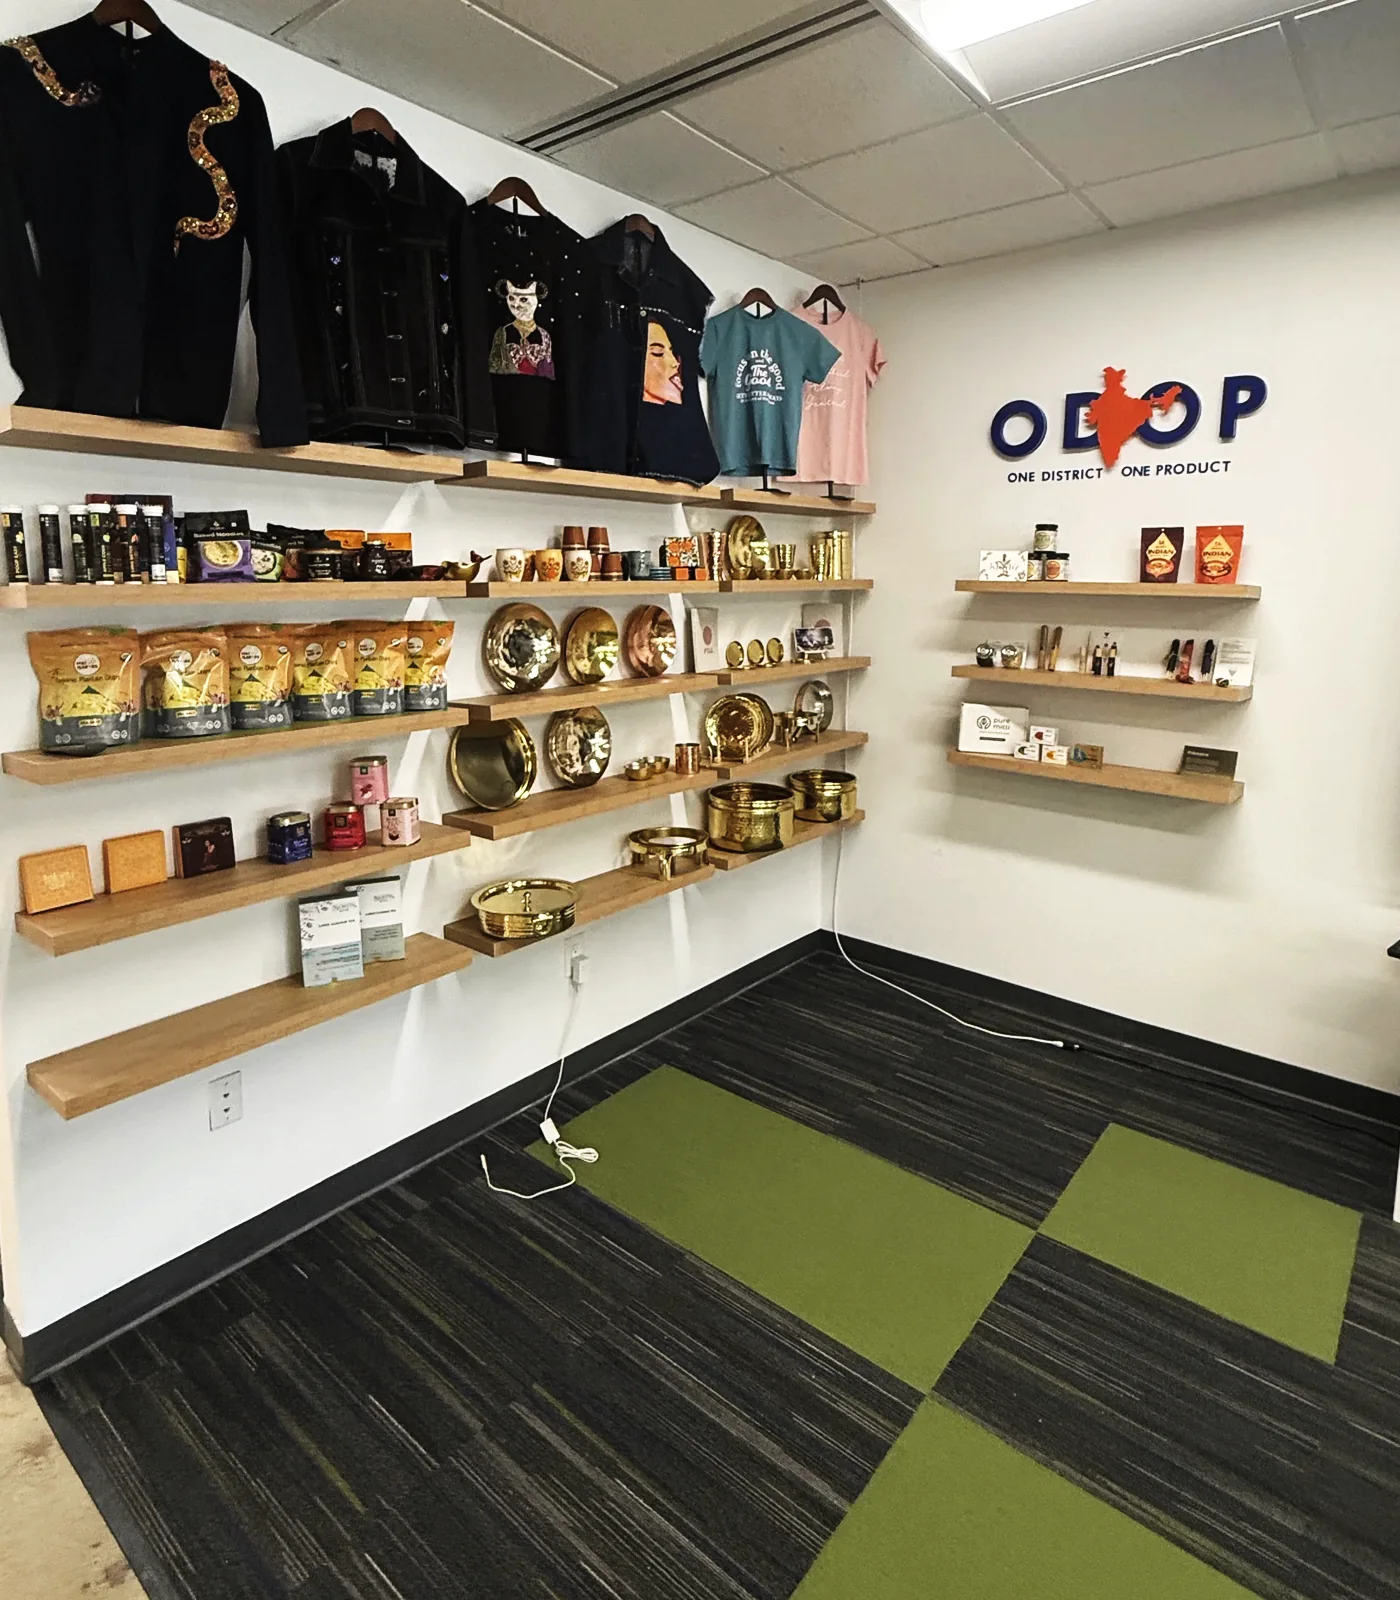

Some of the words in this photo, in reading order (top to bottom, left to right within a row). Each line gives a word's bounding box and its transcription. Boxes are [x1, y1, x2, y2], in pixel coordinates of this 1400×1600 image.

[750, 364, 768, 378] The
[768, 363, 785, 390] good
[1007, 472, 1036, 484] ONE
[1041, 468, 1104, 483] DISTRICT
[1121, 465, 1151, 478] ONE
[1156, 460, 1232, 477] PRODUCT
